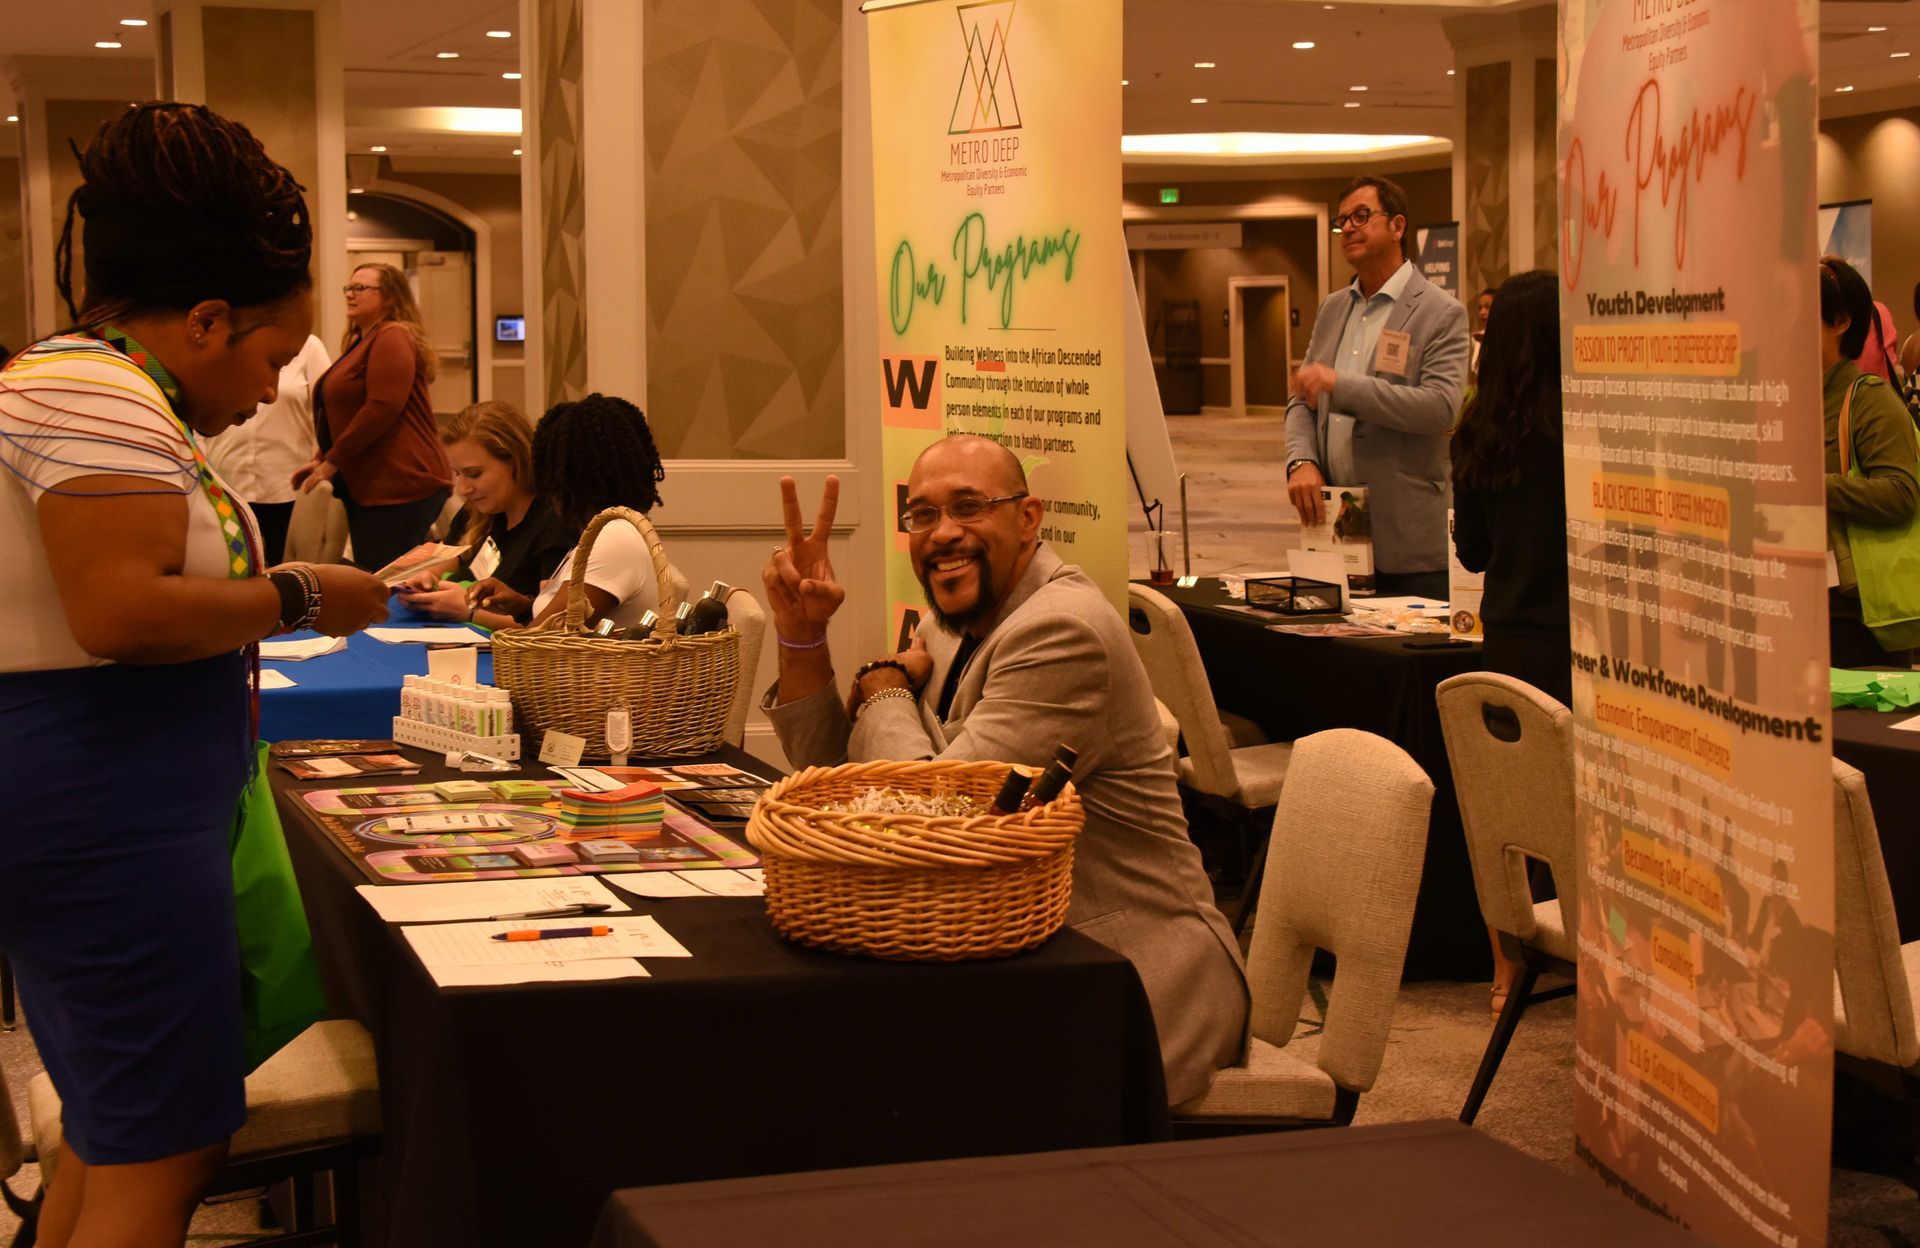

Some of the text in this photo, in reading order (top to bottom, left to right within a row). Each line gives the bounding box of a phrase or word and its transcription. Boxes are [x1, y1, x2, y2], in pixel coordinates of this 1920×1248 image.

[950, 137, 1019, 166] METRO DEEP
[941, 170, 975, 183] Metropolitan
[976, 168, 998, 182] Diversity
[1004, 166, 1027, 178] Economic
[1564, 78, 1756, 292] Our Programs
[967, 184, 1005, 198] Equity Partners
[891, 213, 1080, 335] Our Programs
[1587, 287, 1725, 319] Youth Development
[945, 346, 1101, 367] Building Wellness into the African Descended
[1575, 336, 1604, 362] PASSION
[1606, 336, 1616, 362] TO
[1618, 336, 1644, 362] PROFIT
[1650, 335, 1672, 362] YOUTH
[883, 359, 937, 409] W
[945, 373, 1089, 396] Community through the inclusion of whole
[1765, 379, 1789, 407] high
[946, 402, 1101, 427] person elements in each of our programs and
[1014, 433, 1021, 448] to
[1022, 433, 1042, 450] health
[1043, 437, 1076, 455] partners.
[1762, 420, 1783, 441] skill
[1054, 501, 1100, 520] community,
[1593, 482, 1616, 510] BLACK
[1618, 485, 1663, 517] EXCELLENCE
[1668, 491, 1692, 521] CAREER
[1041, 525, 1075, 544] and in our
[1770, 558, 1786, 579] the
[1600, 655, 1610, 679] &
[1612, 658, 1697, 707] Workforce
[1698, 684, 1822, 743] Development
[1596, 695, 1731, 771] Economic Empowerment Conference
[1625, 839, 1664, 888] Becoming
[1667, 858, 1681, 890] One
